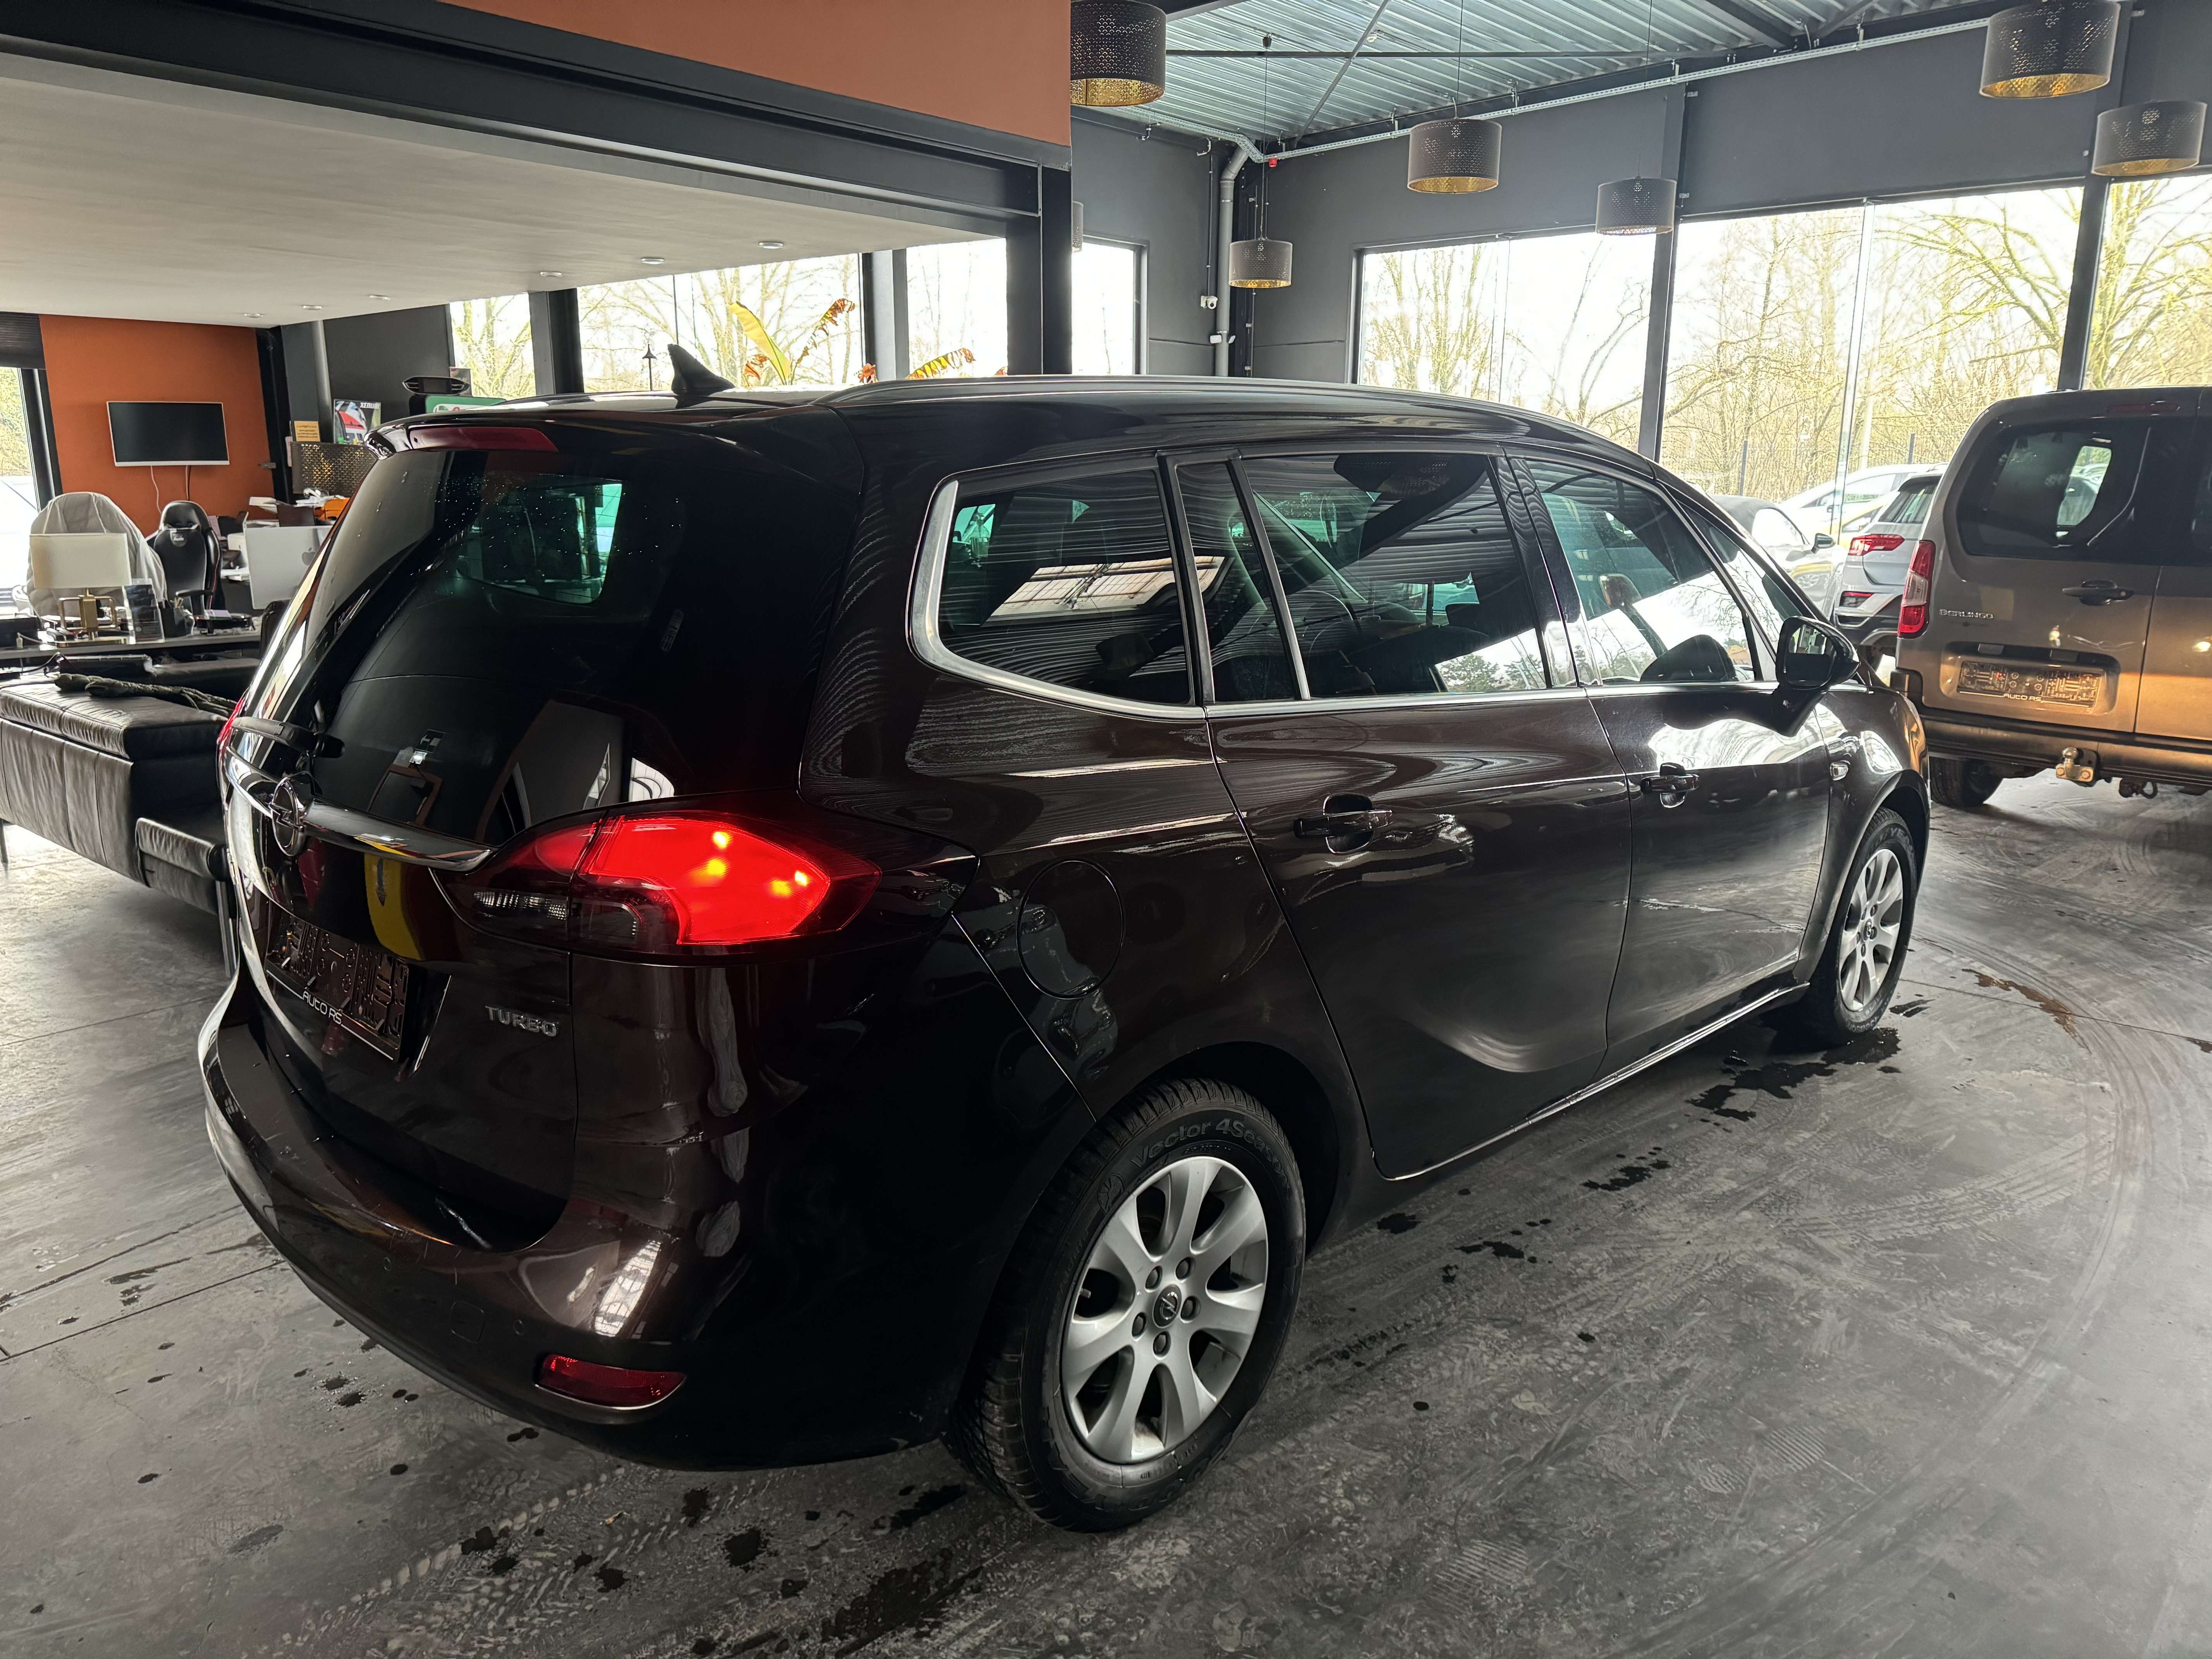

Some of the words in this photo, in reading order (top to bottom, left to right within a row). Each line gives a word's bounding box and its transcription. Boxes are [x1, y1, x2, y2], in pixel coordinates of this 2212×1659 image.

[1939, 609, 1993, 619] BERLINGO
[329, 1008, 342, 1025] RS
[485, 1005, 558, 1037] TURBO
[1130, 1120, 1213, 1166] Vector
[1214, 1117, 1293, 1201] 4Seasons
